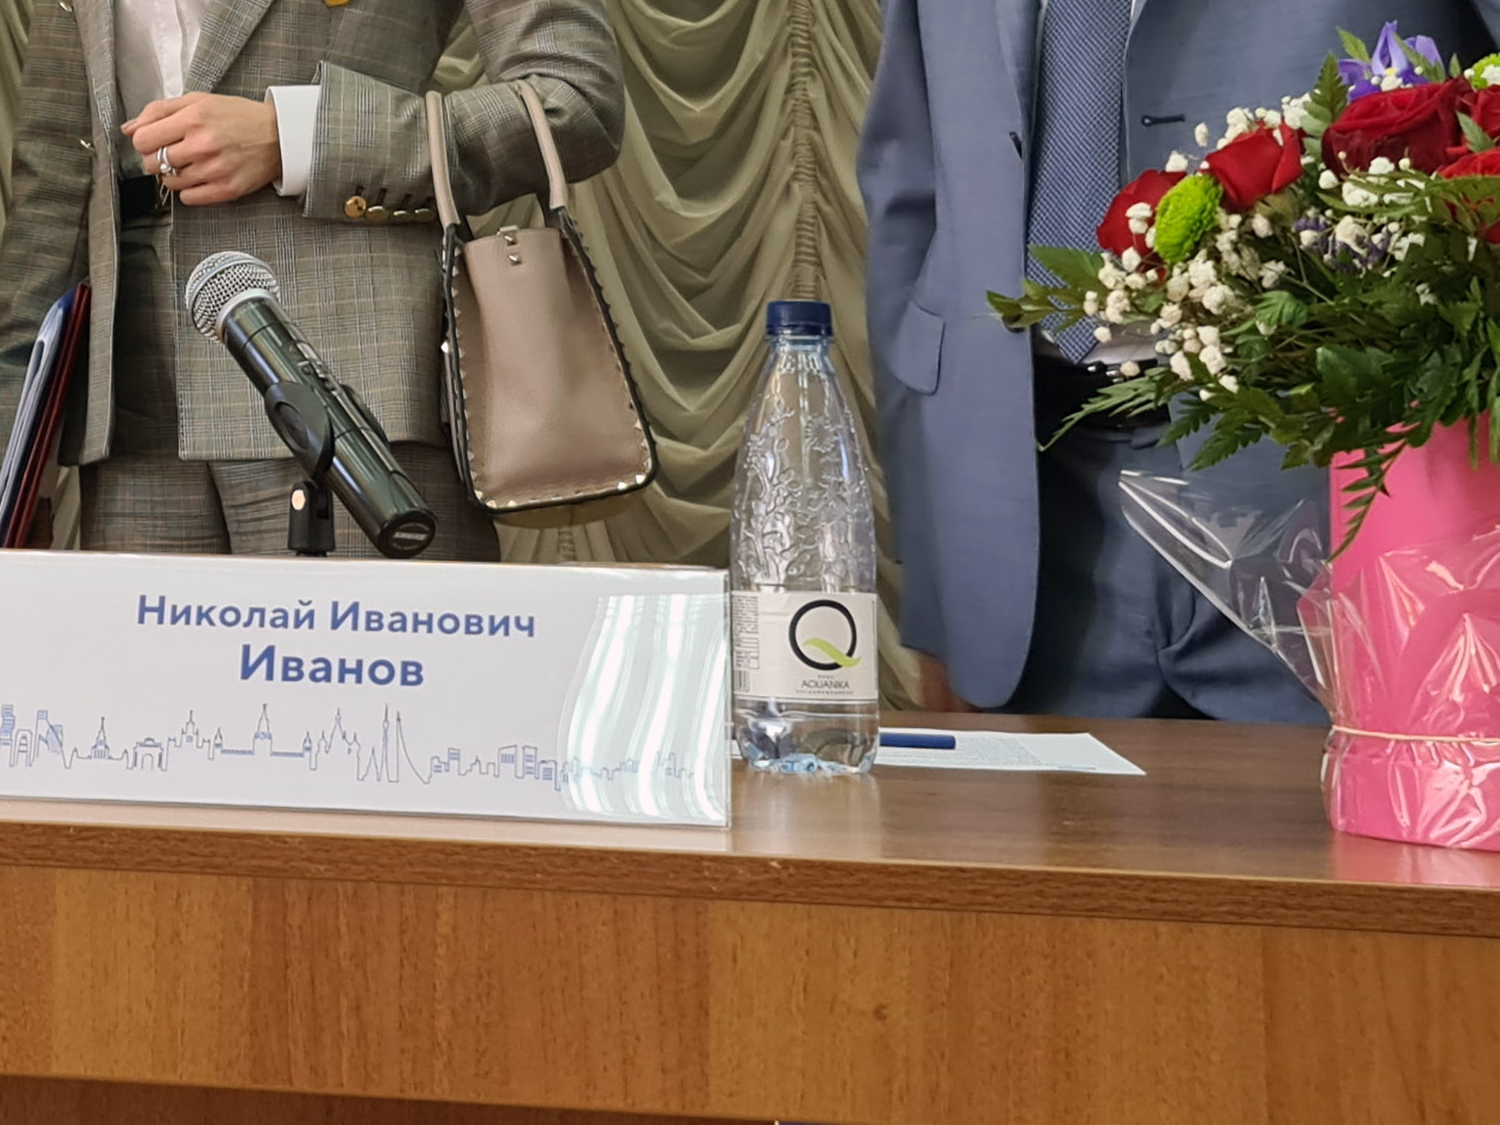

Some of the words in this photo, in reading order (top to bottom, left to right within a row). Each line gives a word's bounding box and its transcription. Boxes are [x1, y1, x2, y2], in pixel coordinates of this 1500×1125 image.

[136, 594, 317, 632] Николай
[329, 600, 536, 639] Иванович
[239, 644, 425, 687] Иванов
